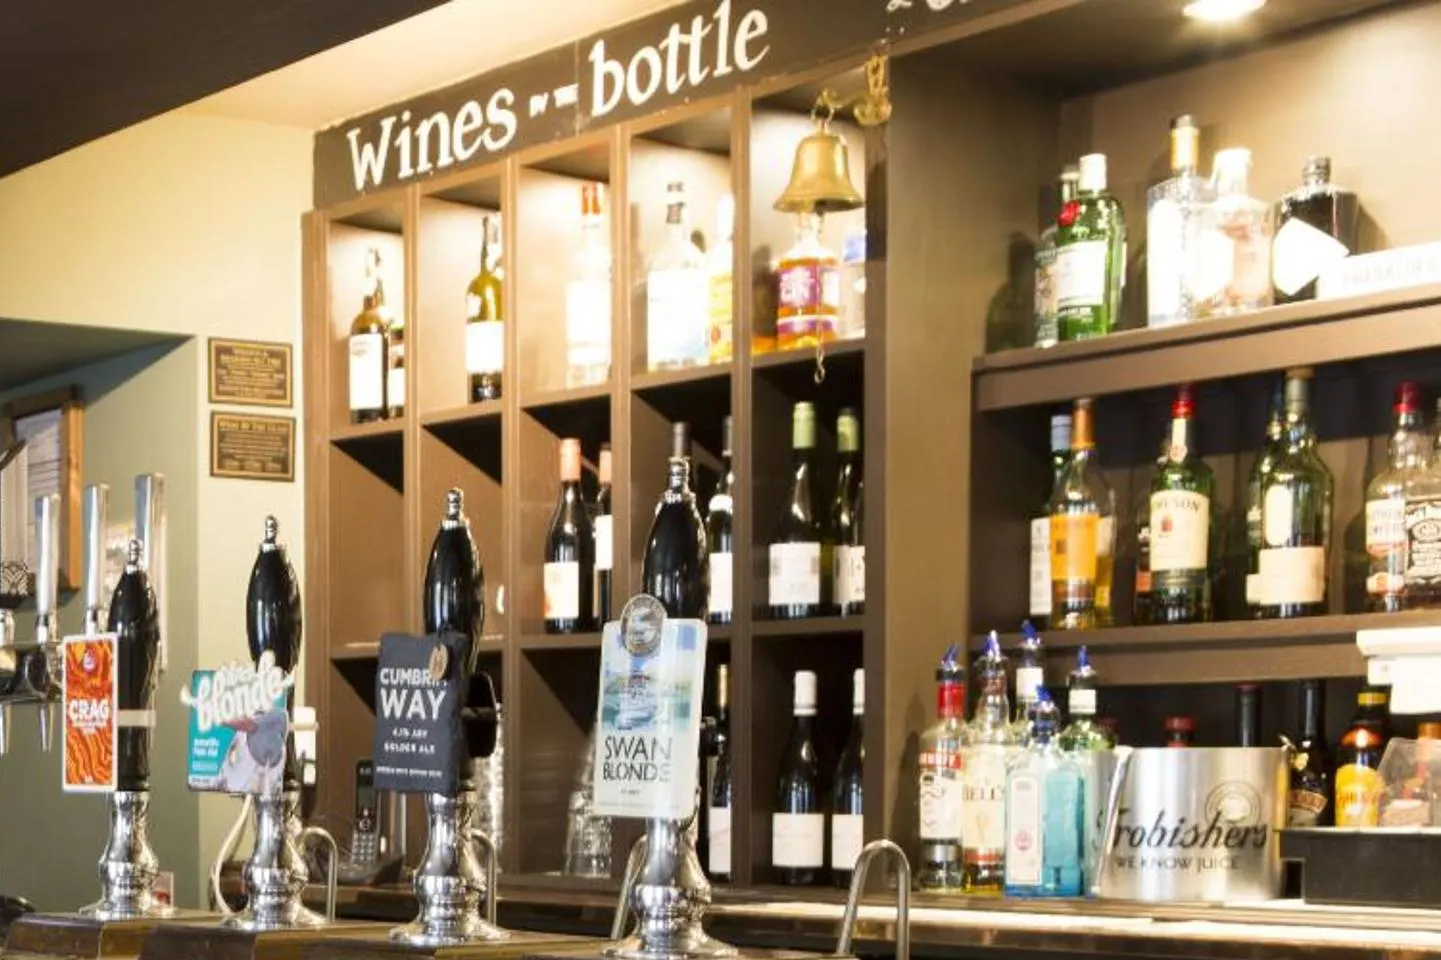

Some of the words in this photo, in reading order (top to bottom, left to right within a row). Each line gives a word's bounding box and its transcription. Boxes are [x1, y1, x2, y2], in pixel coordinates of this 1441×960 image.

[346, 88, 518, 191] Wines
[588, 0, 771, 118] bottle
[380, 667, 447, 687] CUMBR
[380, 688, 447, 721] WAY
[604, 736, 672, 761] SWAN
[602, 761, 672, 782] BLONDE
